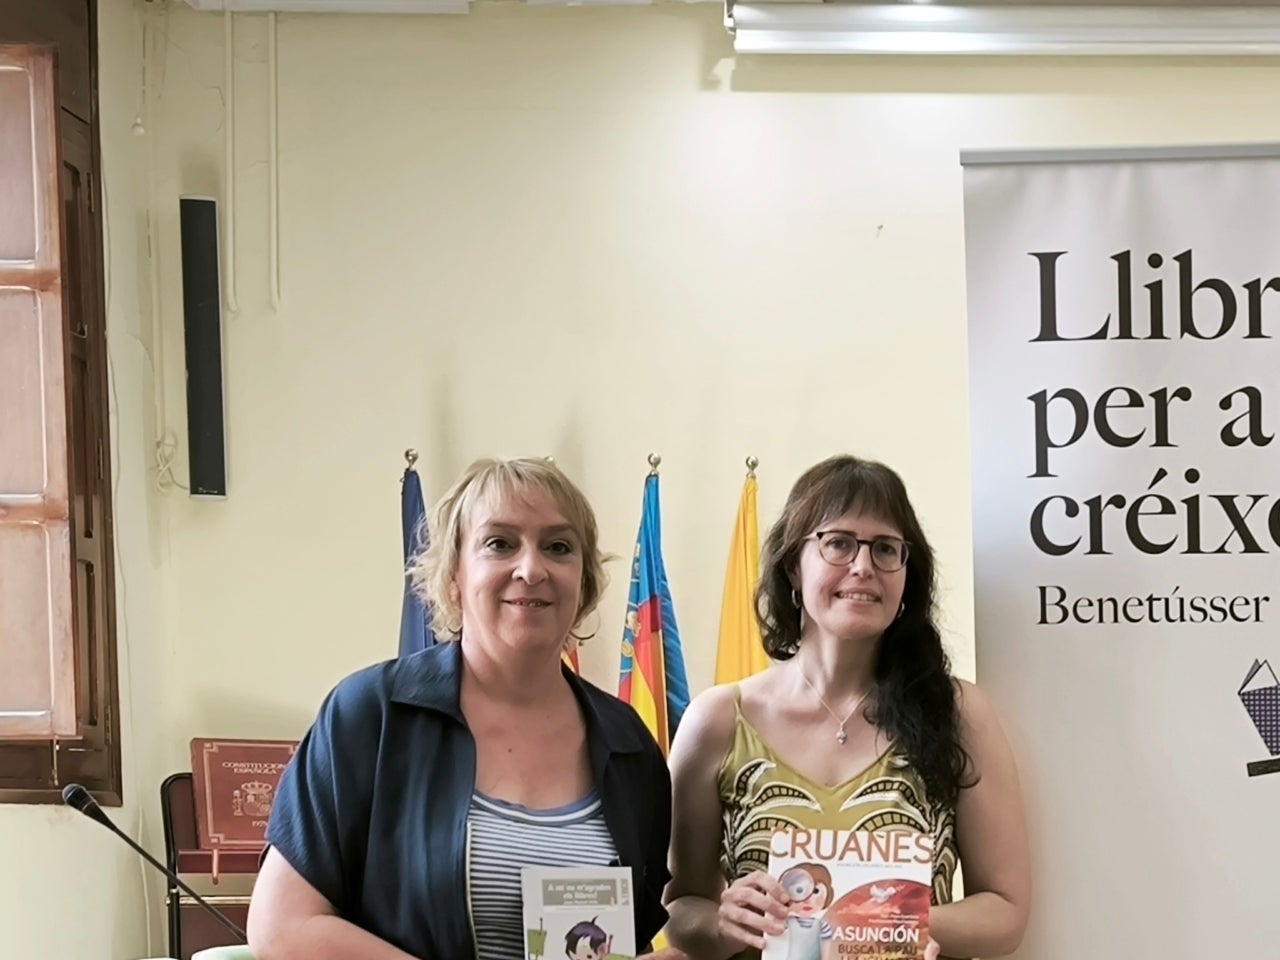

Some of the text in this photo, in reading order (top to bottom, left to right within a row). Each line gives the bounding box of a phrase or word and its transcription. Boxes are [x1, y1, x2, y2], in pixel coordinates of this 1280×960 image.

[1026, 385, 1276, 479] per a
[1036, 585, 1271, 626] Benetússer
[832, 925, 919, 943] ASUNCIÓN
[838, 944, 875, 955] BUSCA
